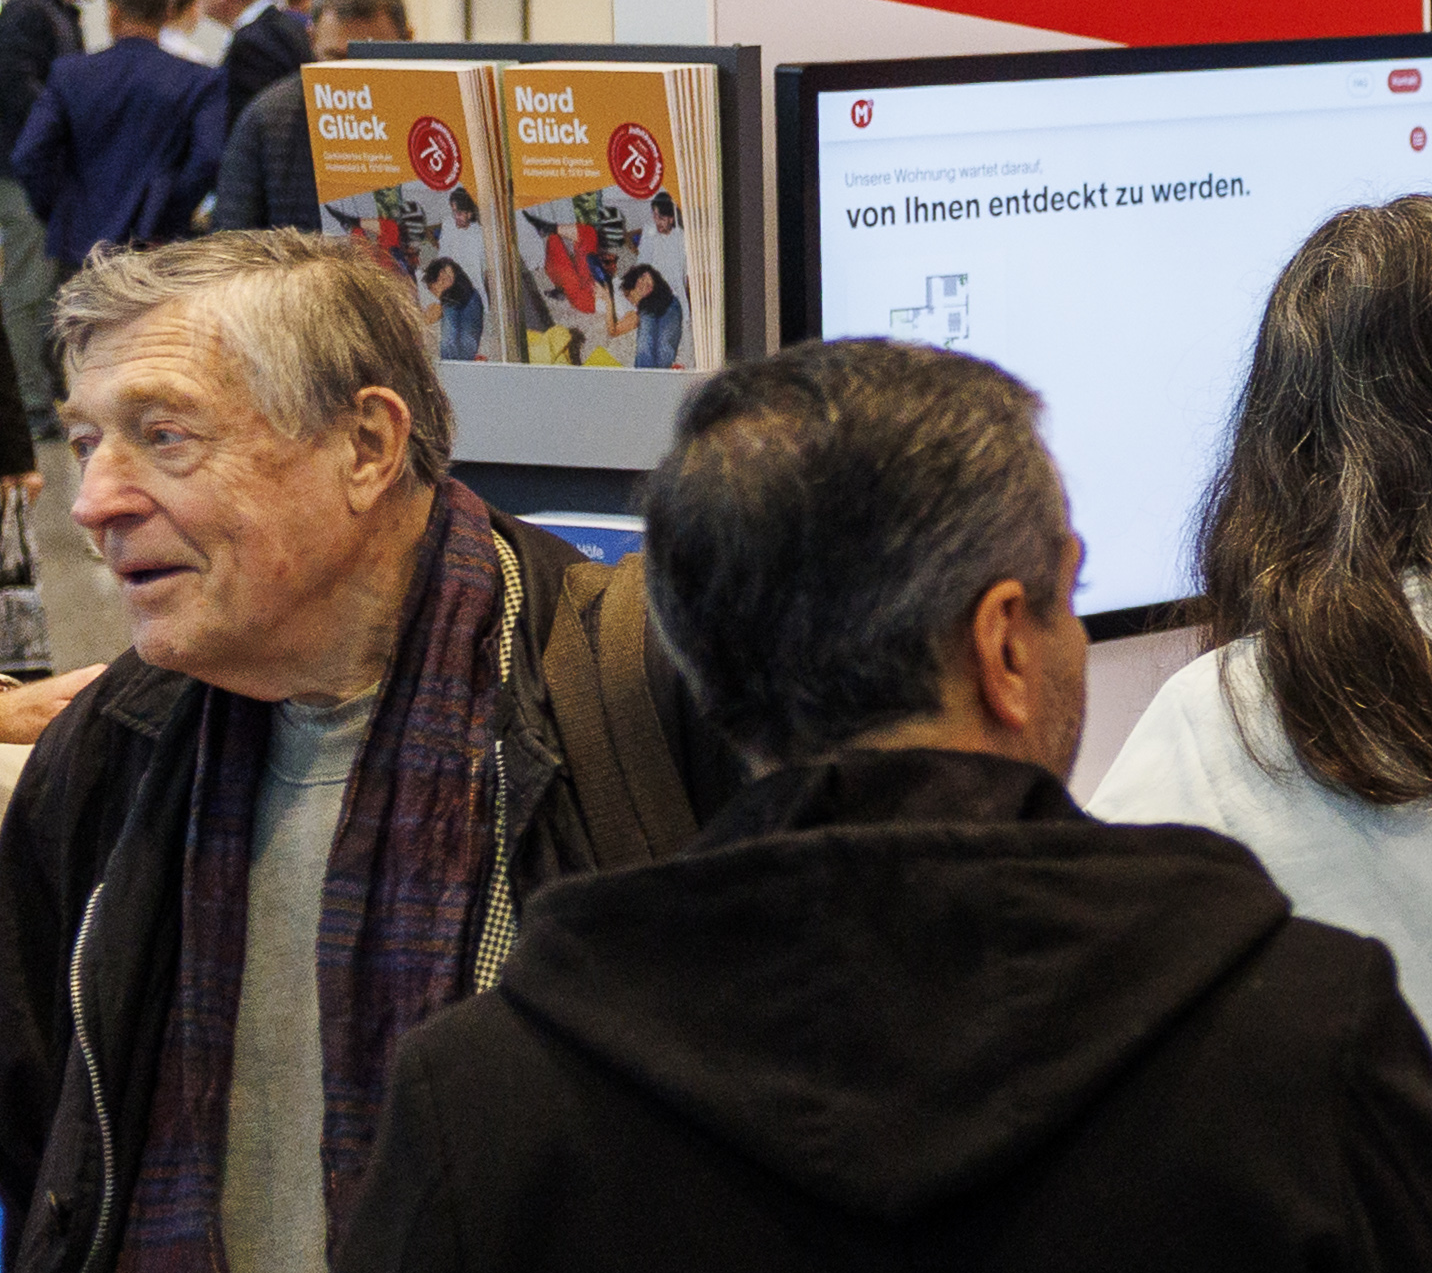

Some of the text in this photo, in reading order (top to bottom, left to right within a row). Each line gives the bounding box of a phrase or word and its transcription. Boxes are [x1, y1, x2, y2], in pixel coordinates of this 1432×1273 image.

[314, 83, 373, 111] Nord
[514, 86, 575, 114] Nord
[318, 114, 388, 142] Glück
[518, 117, 590, 145] Glück
[419, 135, 447, 172] 75
[621, 144, 648, 179] 75
[844, 170, 892, 189] Unsere
[893, 166, 957, 186] Wohnung
[958, 162, 999, 180] wartet
[845, 173, 1252, 230] von Ihnen entdeckt zu werden.
